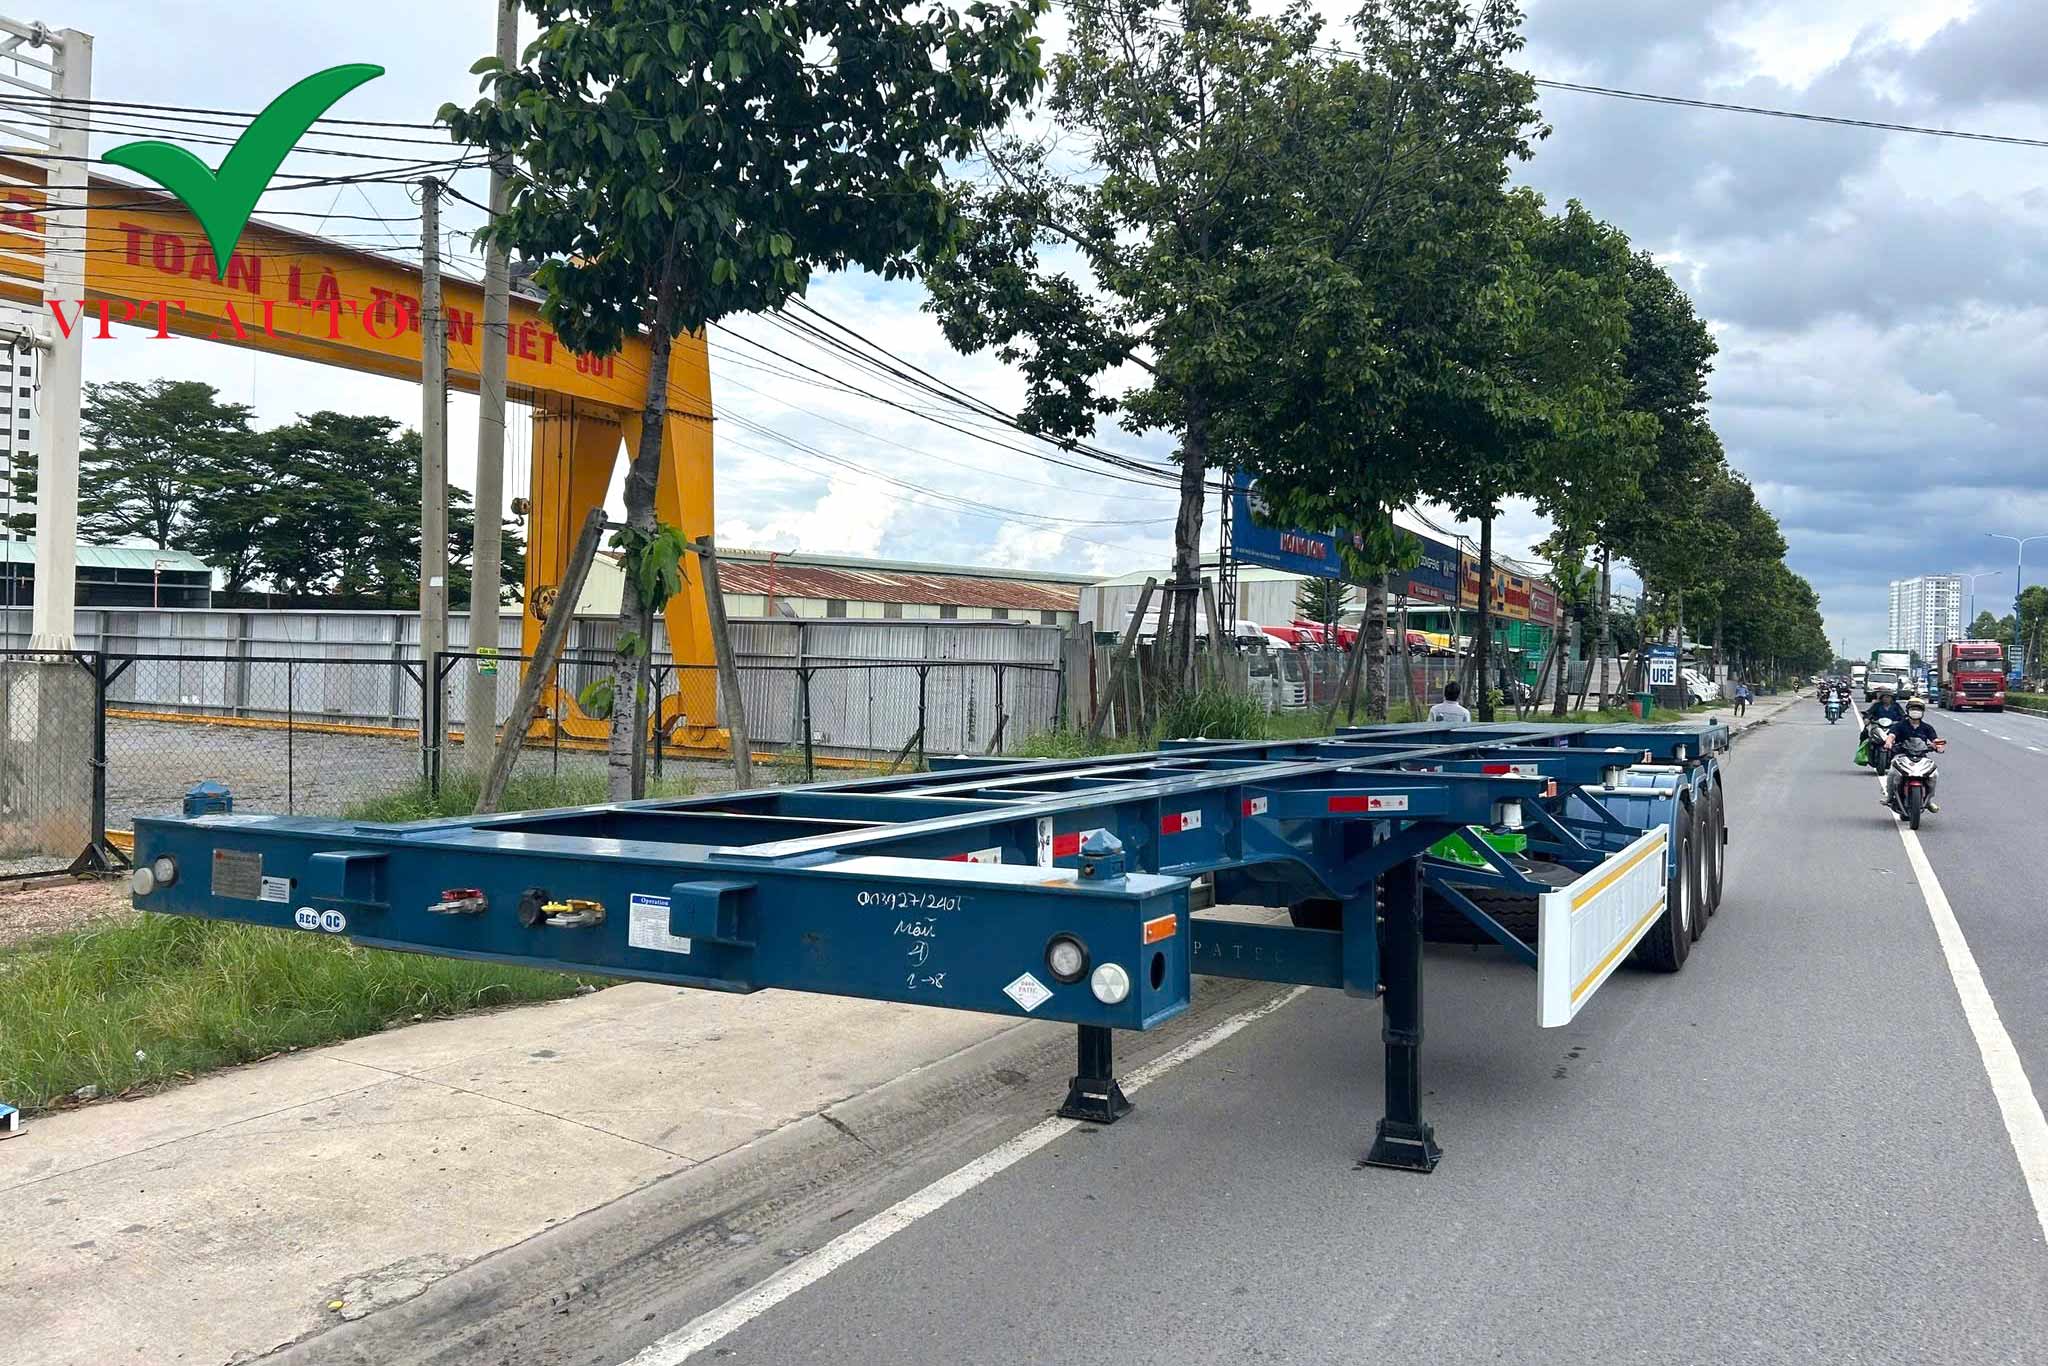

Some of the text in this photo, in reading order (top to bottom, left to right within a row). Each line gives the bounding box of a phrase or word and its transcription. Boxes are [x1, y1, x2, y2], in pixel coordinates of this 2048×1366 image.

[288, 264, 344, 315] LÀ
[370, 286, 474, 346] TRN
[299, 912, 317, 925] REG
[325, 914, 340, 928] QC
